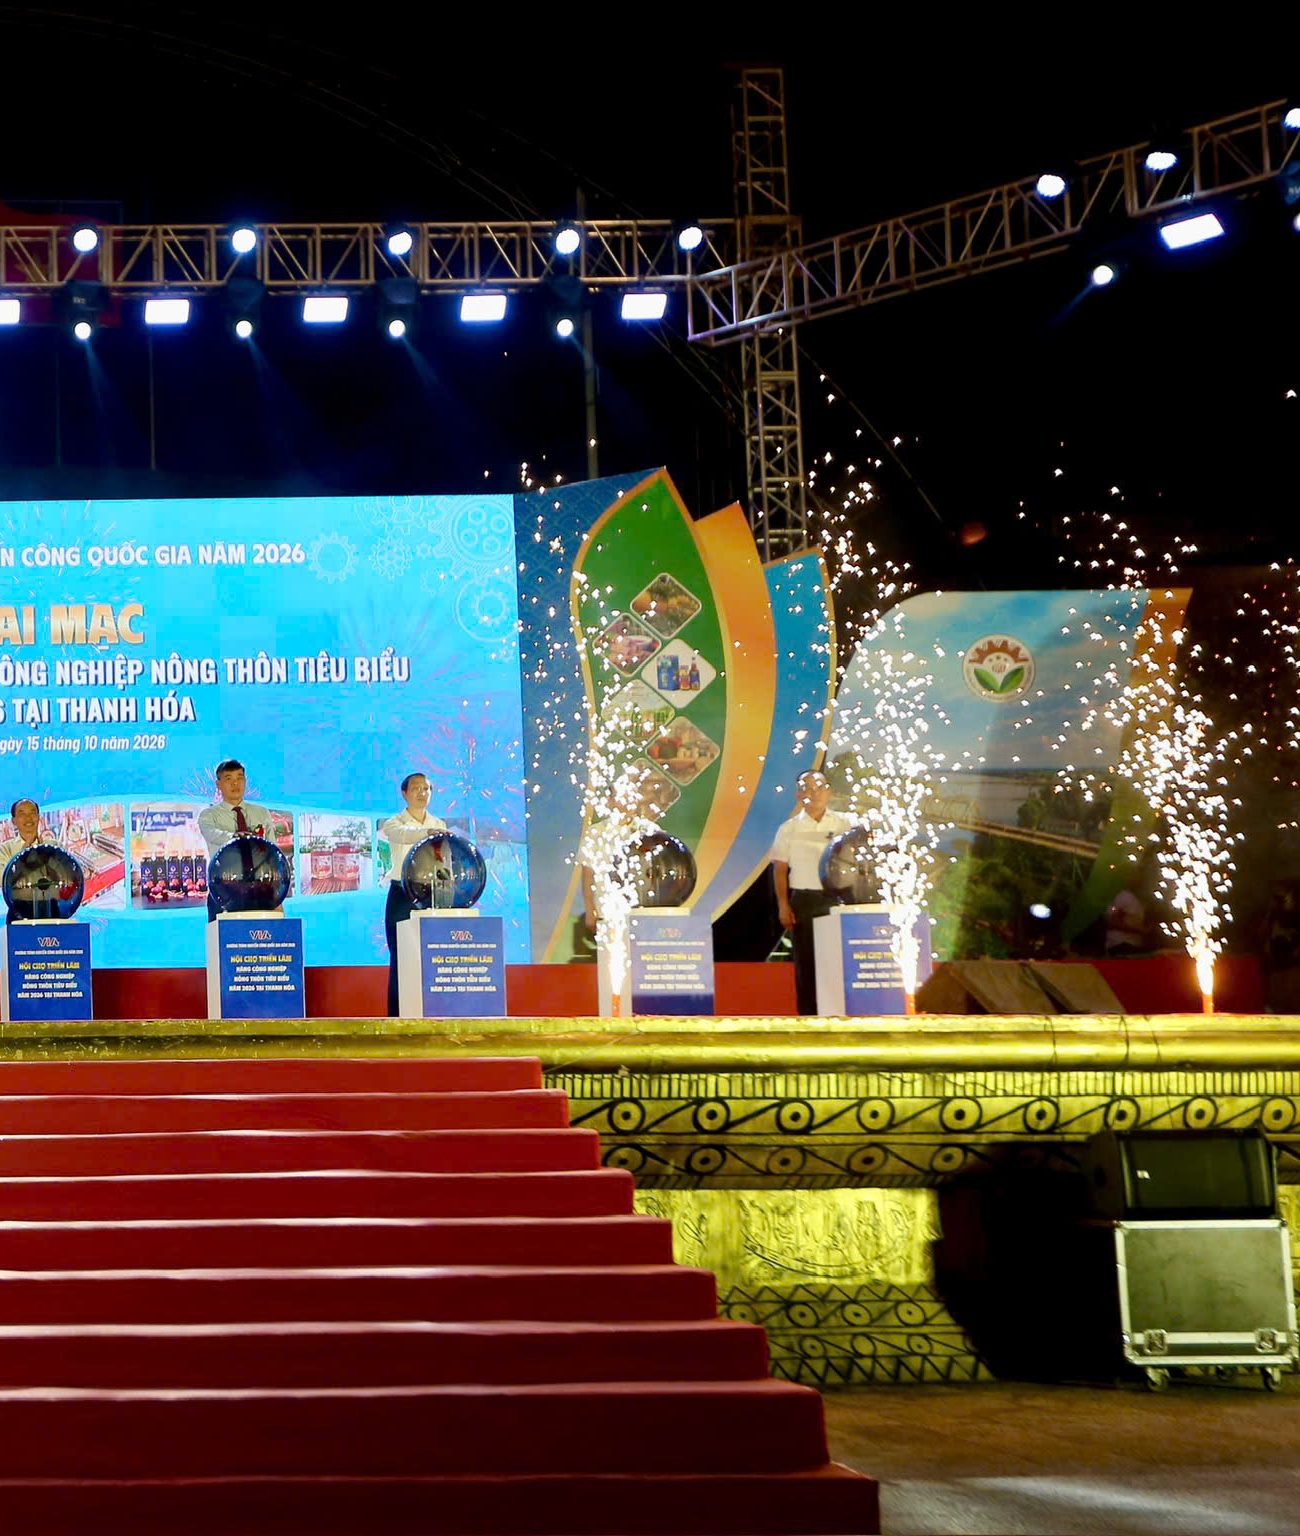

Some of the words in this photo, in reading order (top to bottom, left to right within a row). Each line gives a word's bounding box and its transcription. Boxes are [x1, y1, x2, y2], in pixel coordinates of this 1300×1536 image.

[22, 543, 81, 566] CÔNG
[88, 540, 149, 567] QUỐC
[155, 545, 191, 565] GIA
[198, 541, 246, 564] NĂM
[252, 543, 306, 564] 2026
[50, 603, 145, 650] MẠC
[55, 653, 144, 690] NGHIỆP
[151, 652, 218, 685] NÔNG
[224, 650, 289, 684] THÔN
[294, 650, 348, 683] TIÊU
[354, 646, 411, 683] BIỂU
[12, 697, 51, 728] TẠI
[57, 696, 138, 723] THANH
[145, 690, 197, 723] HÓA
[27, 736, 40, 750] 15
[43, 735, 80, 753] tháng
[84, 735, 98, 750] 10
[101, 735, 130, 750] năm
[133, 734, 166, 750] 2026
[38, 937, 59, 946] VIA
[250, 930, 271, 940] VIA
